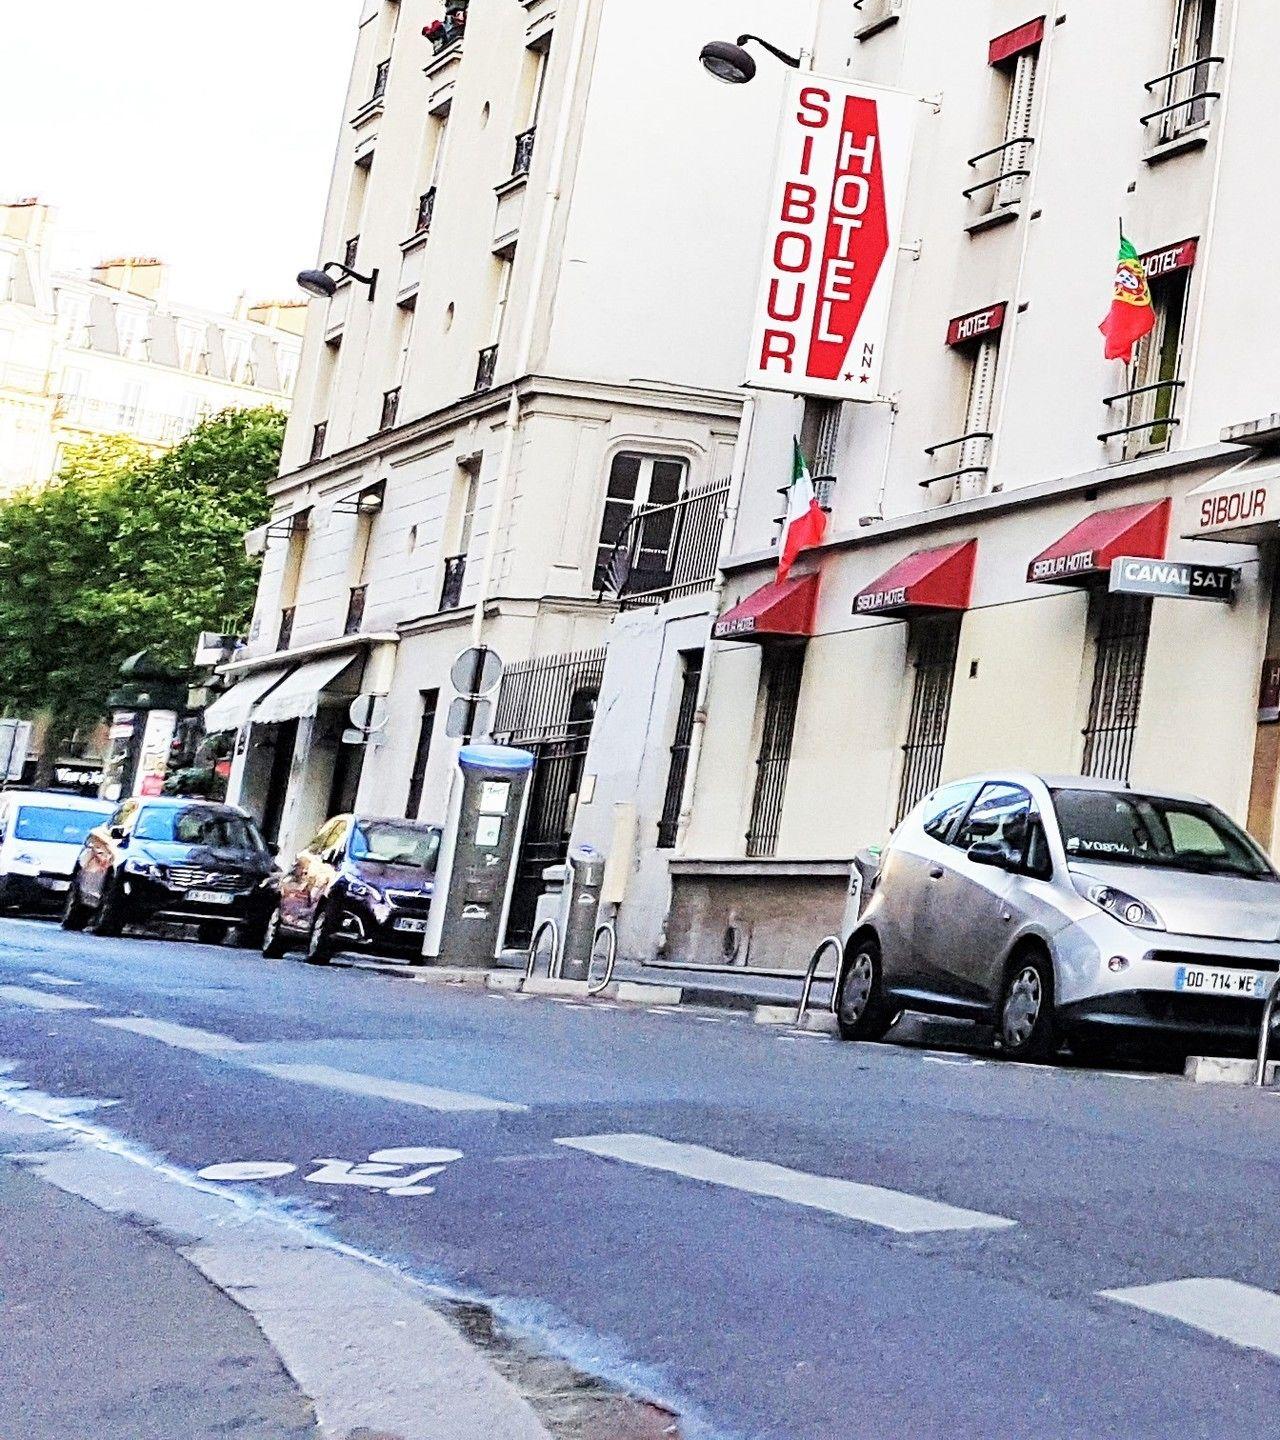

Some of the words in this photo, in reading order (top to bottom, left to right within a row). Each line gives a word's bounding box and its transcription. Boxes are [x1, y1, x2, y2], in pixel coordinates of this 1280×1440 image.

[759, 87, 830, 373] SIBOUR
[818, 131, 876, 344] HOTEL
[957, 311, 990, 339] HOTEL
[1200, 488, 1267, 527] SIBOUR
[1033, 557, 1065, 578] SIBOUR
[1065, 550, 1093, 572] HOTEL
